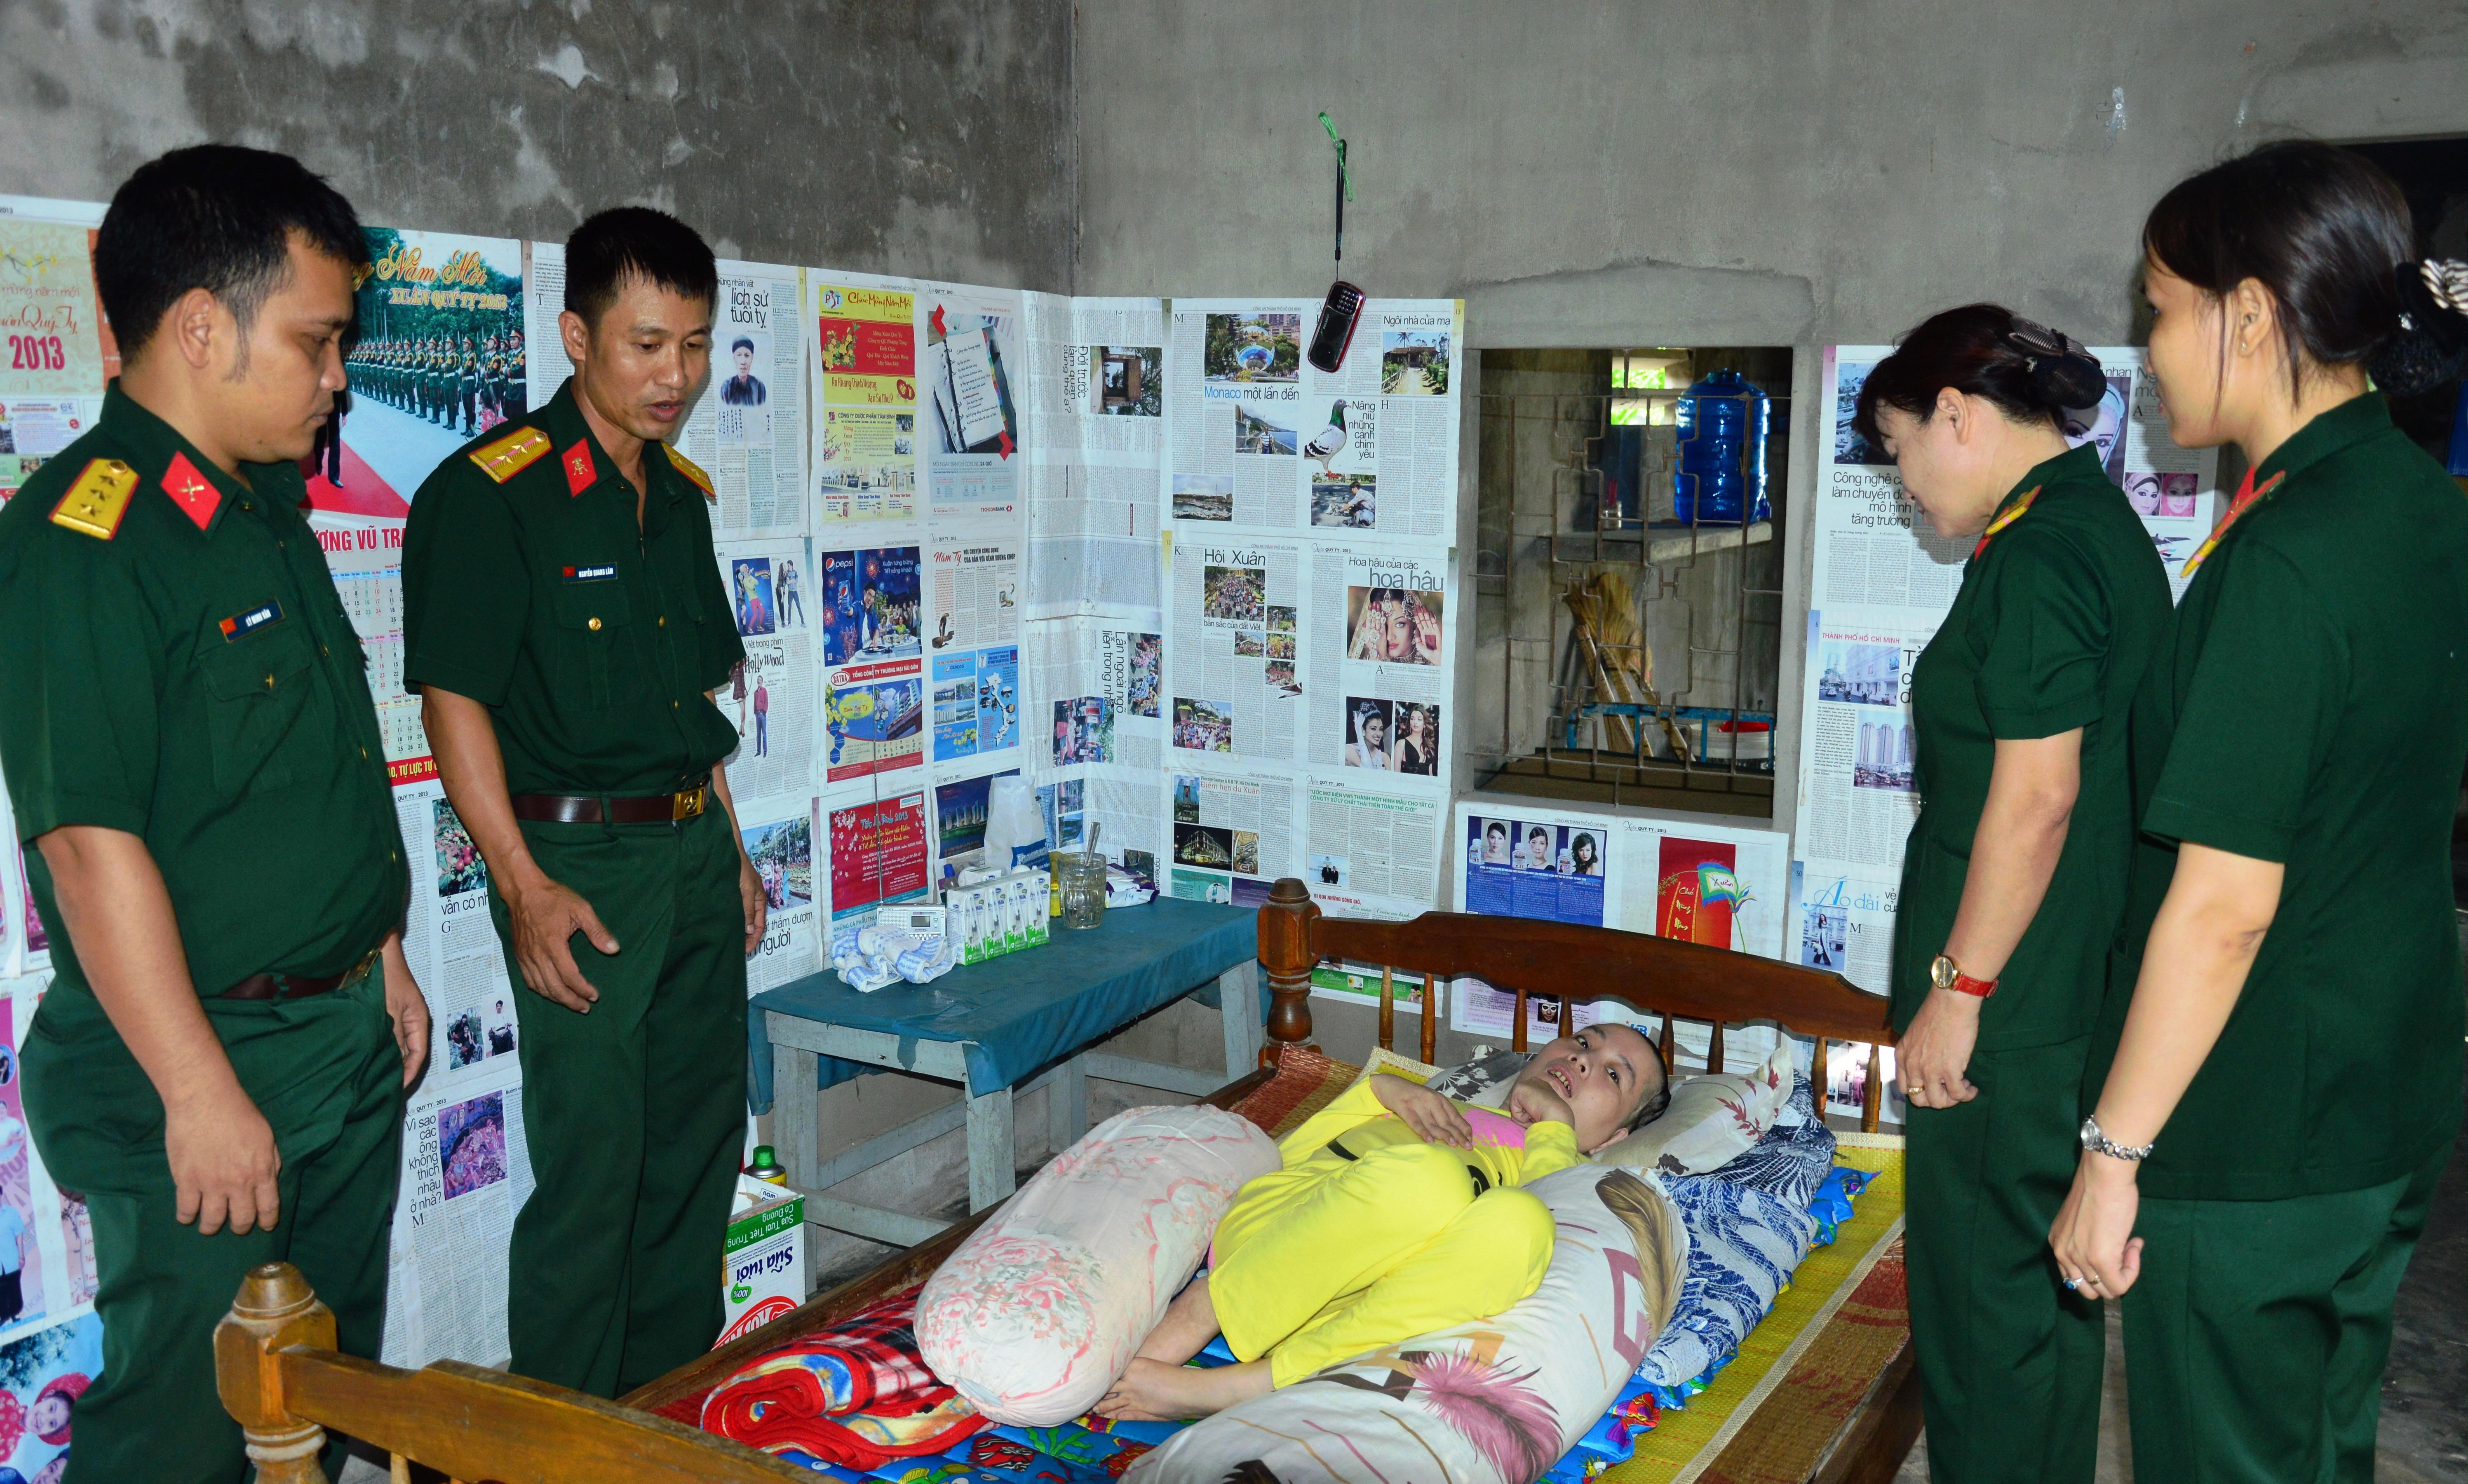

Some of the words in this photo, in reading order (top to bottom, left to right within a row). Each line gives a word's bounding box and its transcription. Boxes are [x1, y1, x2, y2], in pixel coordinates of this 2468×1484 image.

[377, 245, 439, 281] Năm
[442, 249, 487, 286] Mới
[732, 279, 746, 287] nhân
[389, 286, 429, 306] XUÂN
[431, 289, 460, 309] QUÝ
[477, 293, 507, 310] 2013
[754, 290, 769, 307] sử
[730, 302, 753, 324] tuổi
[755, 308, 766, 329] tỵ
[1383, 315, 1402, 327] Ngôi
[1404, 314, 1418, 325] nhà
[1420, 314, 1435, 325] của
[9, 334, 65, 370] 2013
[1205, 386, 1241, 399] Monaco
[1243, 386, 1261, 401] một
[1264, 385, 1278, 400] lần
[1281, 385, 1299, 400] đến
[1352, 400, 1376, 412] Nâng
[1362, 411, 1375, 420] niu
[1348, 420, 1375, 432] những
[1354, 429, 1375, 439] cánh
[1354, 440, 1375, 449] chim
[1359, 451, 1374, 460] yêu
[1833, 471, 1862, 486] Công
[1865, 472, 1891, 488] nghệ
[1832, 486, 1850, 498] làm
[1852, 485, 1890, 502] chuyển
[1869, 501, 1886, 512] mô
[1851, 513, 1874, 527] tăng
[1877, 513, 1911, 529] trưởng
[356, 525, 377, 550] VŨ
[835, 559, 853, 569] pepsi
[933, 551, 951, 563] Năm
[1205, 548, 1225, 566] Hội
[1232, 550, 1266, 566] Xuân
[1349, 556, 1367, 567] Hoa
[1369, 558, 1384, 569] hậu
[1386, 558, 1402, 569] của
[1403, 560, 1418, 570] các
[593, 568, 605, 577] QUANG
[1369, 567, 1404, 588] hoa
[1410, 570, 1444, 595] hậu
[1204, 619, 1214, 627] bản
[1227, 620, 1238, 629] của
[1238, 621, 1249, 630] đất
[744, 640, 755, 651] Việt
[756, 640, 770, 649] trong
[770, 638, 783, 649] phim
[1115, 631, 1127, 653] Lân
[1822, 631, 1843, 640] THÀNH
[1844, 632, 1858, 641] PHỐ
[1859, 633, 1870, 642] HỒ
[1871, 634, 1882, 643] CHÍ
[1101, 652, 1114, 681] trong
[1114, 656, 1127, 688] ngoài
[833, 674, 848, 683] SATRA
[1114, 691, 1127, 713] ngõ
[399, 763, 409, 778] TỰ
[409, 761, 423, 776] LỰC
[424, 759, 433, 774] TỰ
[1125, 893, 1134, 901] 14
[1801, 875, 1851, 912] Áo
[1854, 893, 1879, 911] dài
[1885, 888, 1896, 900] vẻ
[441, 896, 460, 915] vẫn
[463, 894, 475, 910] có
[441, 921, 451, 933] G
[771, 915, 789, 930] thắm
[792, 911, 812, 925] đượm
[418, 1115, 437, 1129] sao
[419, 1127, 437, 1141] các
[419, 1139, 438, 1153] ông
[409, 1152, 438, 1171] không
[417, 1164, 440, 1181] thích
[417, 1179, 441, 1196] nhậu
[410, 1199, 417, 1213] ở
[418, 1191, 442, 1211] nhà?
[412, 1212, 425, 1229] M
[767, 1246, 793, 1273] Sữa
[736, 1259, 763, 1283] tươi
[733, 1289, 749, 1298] 100%
